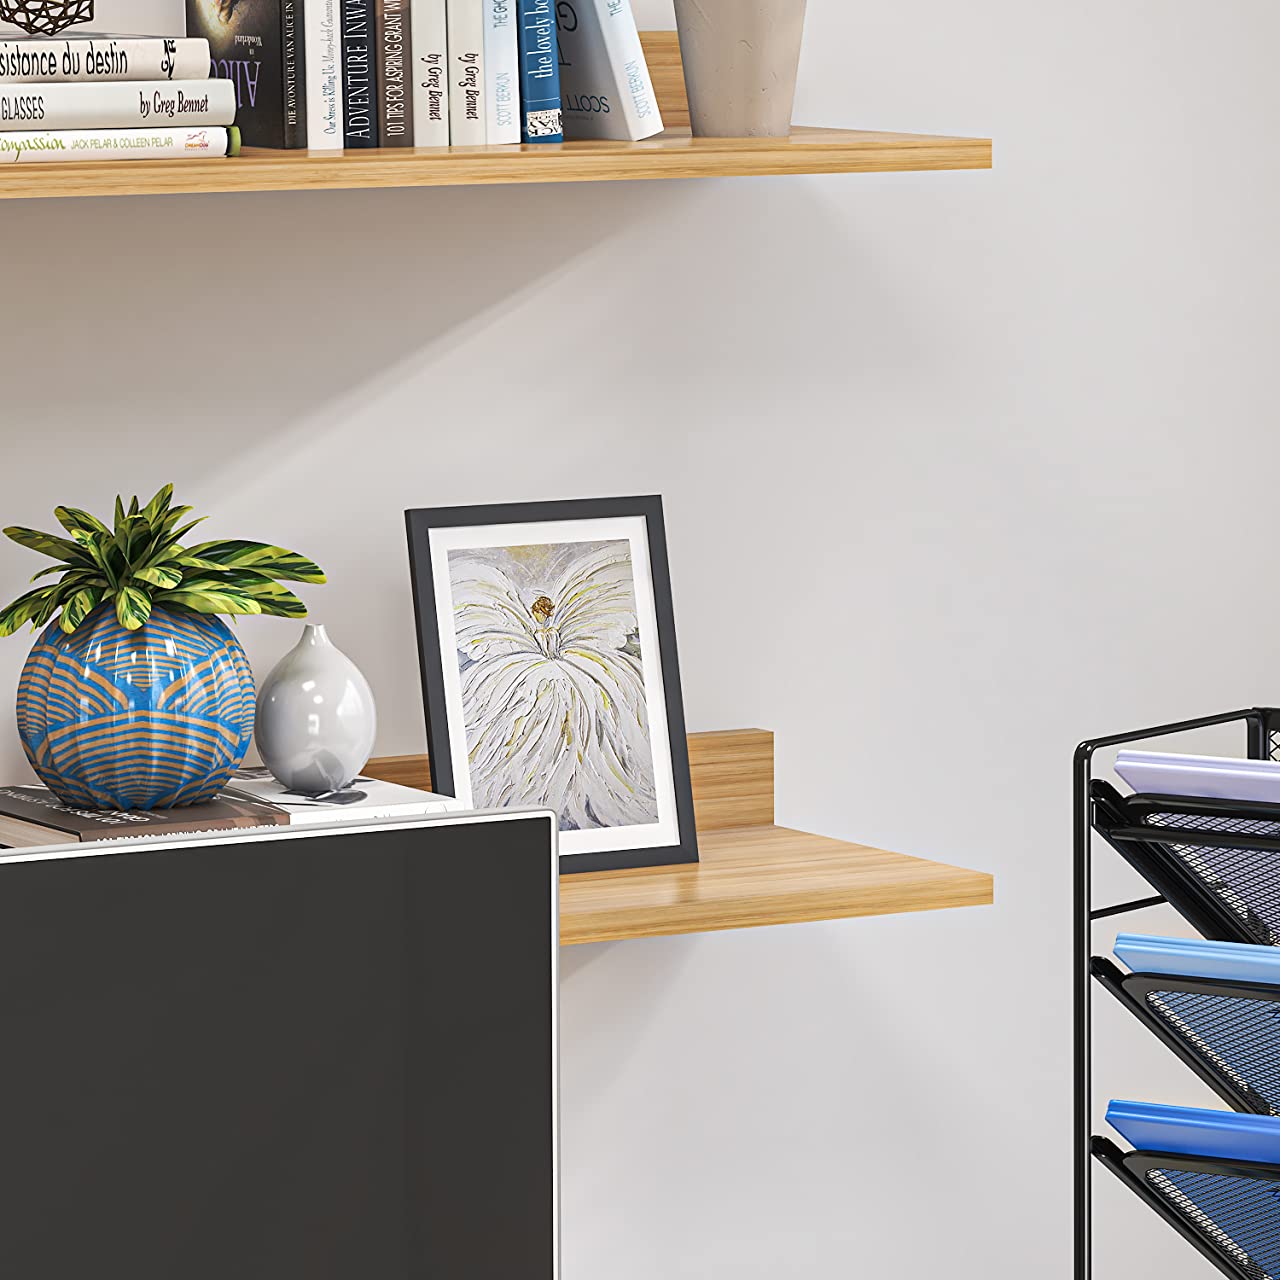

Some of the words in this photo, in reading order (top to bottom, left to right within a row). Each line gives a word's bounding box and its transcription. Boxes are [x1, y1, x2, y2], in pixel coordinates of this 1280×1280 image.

[384, 13, 402, 42] GRANT
[525, 17, 555, 55] lovely
[62, 41, 80, 75] du
[86, 40, 128, 75] destin
[286, 40, 294, 58] VAN
[421, 53, 442, 64] by
[458, 53, 479, 64] by
[384, 45, 404, 82] ASPIRING
[528, 56, 554, 78] the
[421, 68, 443, 88] Greg
[458, 66, 480, 87] Greg
[345, 46, 370, 138] ADVENTURE
[386, 85, 404, 101] FOR
[2, 96, 45, 120] GLASSES
[140, 90, 150, 118] by
[154, 90, 175, 118] Greg
[178, 90, 209, 113] Bennet
[386, 103, 404, 119] TIPS
[428, 90, 443, 120] Bennet
[465, 89, 480, 120] Bennet
[566, 94, 610, 114] SCOTT
[288, 109, 296, 124] DIE
[386, 122, 405, 136] 101
